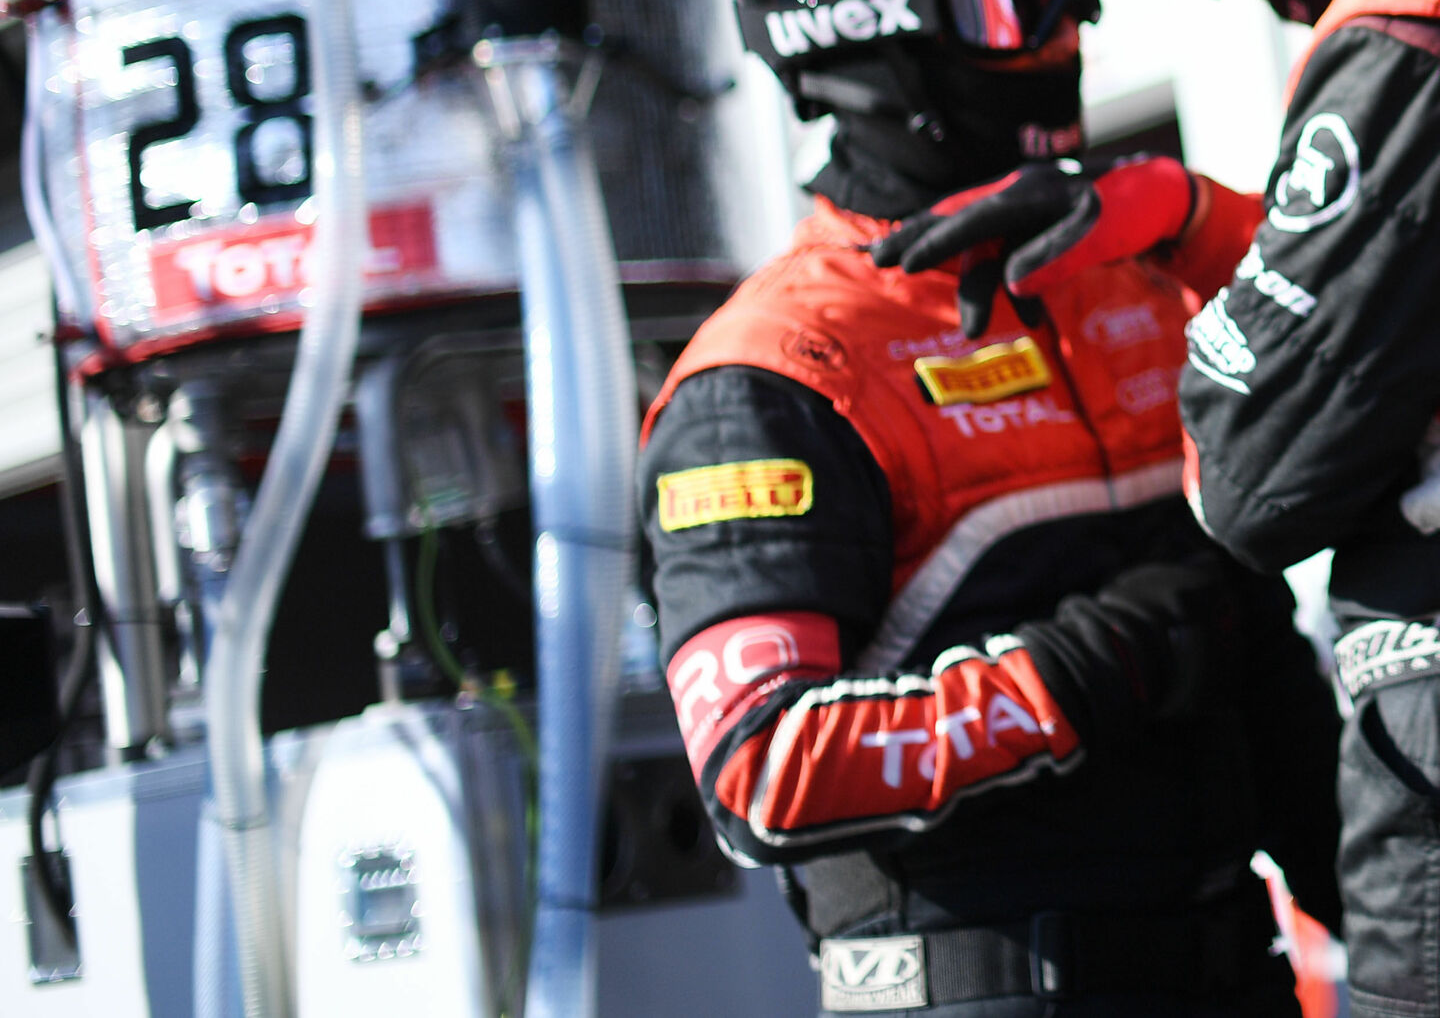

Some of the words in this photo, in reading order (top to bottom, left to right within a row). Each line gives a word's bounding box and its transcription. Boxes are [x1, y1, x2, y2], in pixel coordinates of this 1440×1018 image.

[121, 12, 315, 232] 28
[172, 236, 400, 299] TOT
[940, 395, 1076, 439] TOTAL
